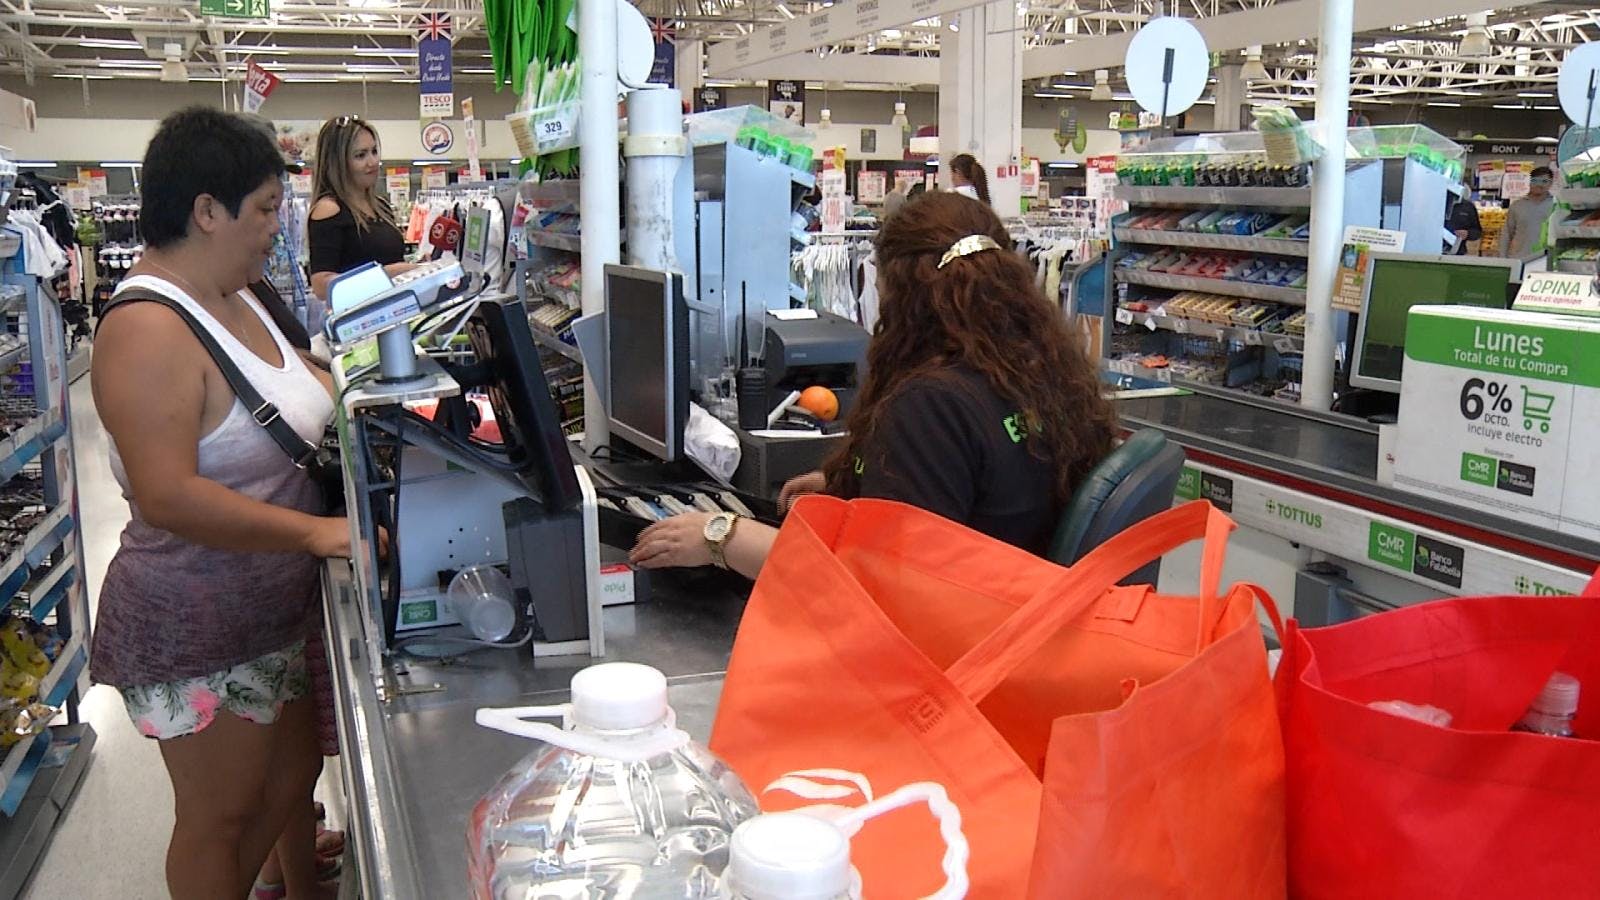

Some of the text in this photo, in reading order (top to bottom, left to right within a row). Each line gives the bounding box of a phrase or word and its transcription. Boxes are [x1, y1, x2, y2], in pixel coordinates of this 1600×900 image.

[423, 96, 451, 104] TESCO
[544, 121, 563, 133] 329
[1491, 145, 1520, 153] SONY
[1530, 280, 1581, 296] OPINA
[1474, 326, 1544, 357] Lunes
[1454, 349, 1569, 377] Total de tu Compra
[1460, 378, 1512, 421] 6%
[1484, 413, 1511, 428] DCTO.
[1505, 431, 1543, 448] electro
[1467, 459, 1490, 474] CMR
[1278, 502, 1322, 528] TOTTUS
[1377, 532, 1405, 554] CMR
[1430, 550, 1453, 566] Banco
[1430, 560, 1461, 578] Falabella
